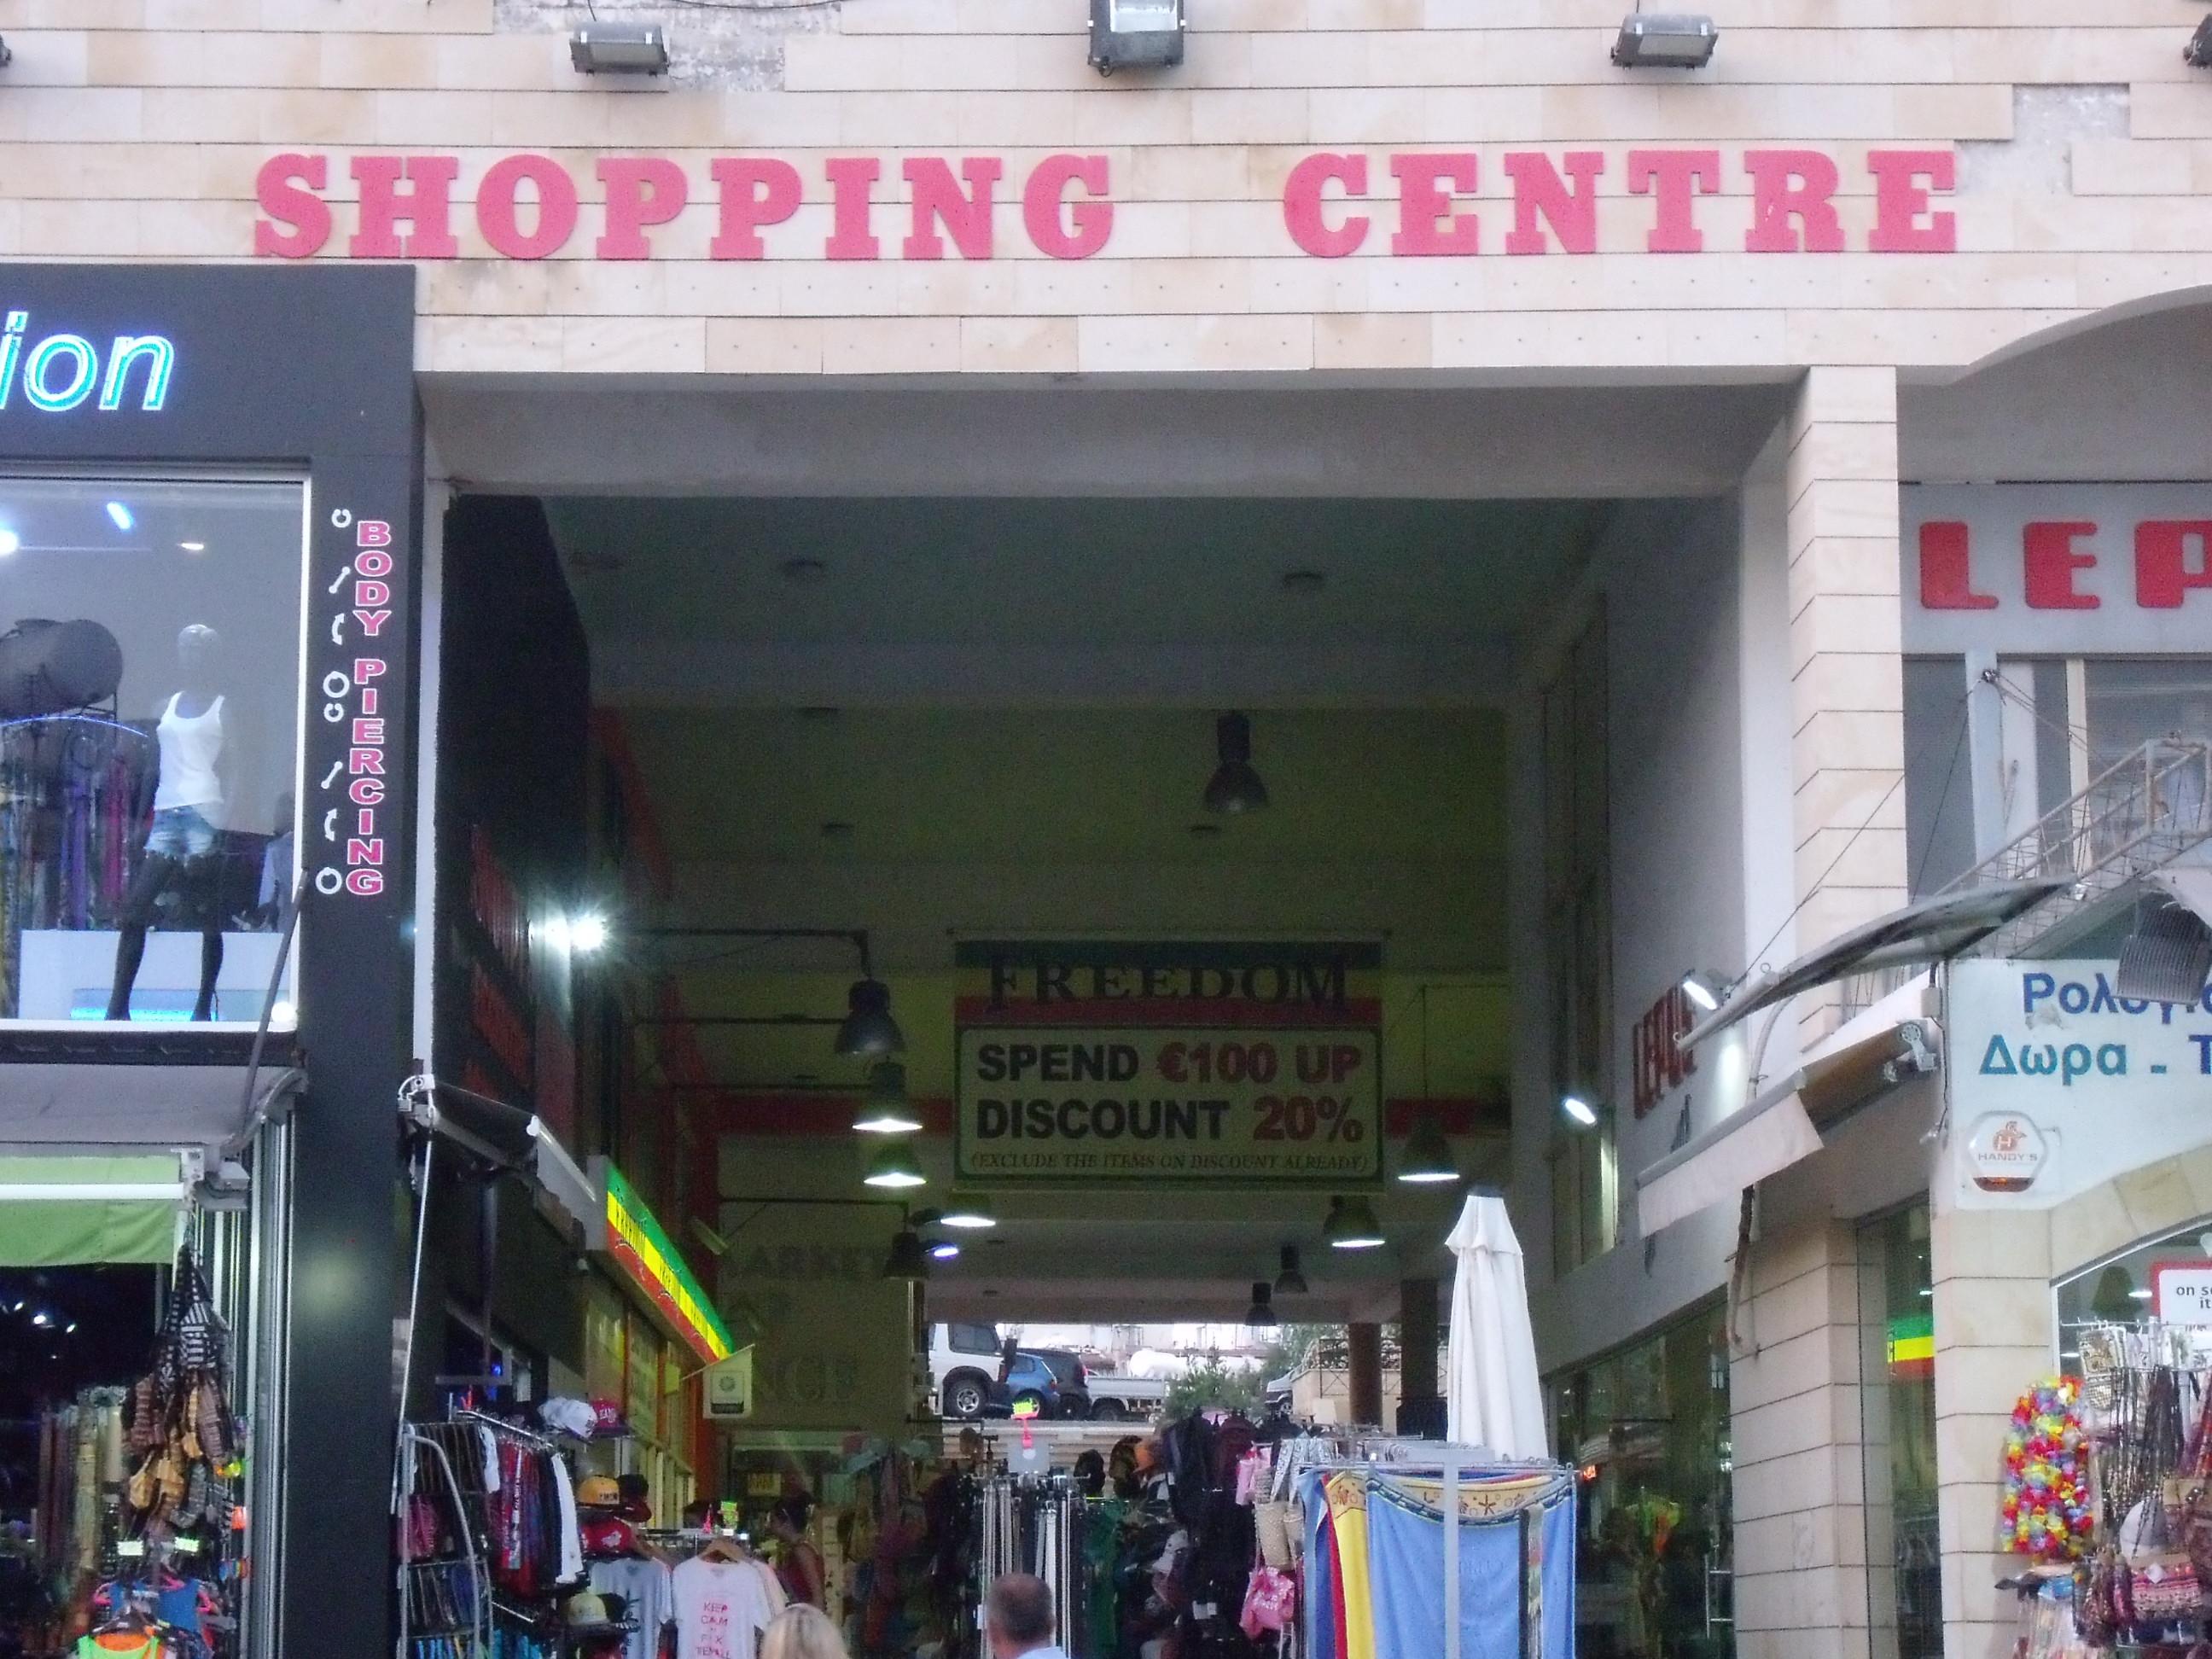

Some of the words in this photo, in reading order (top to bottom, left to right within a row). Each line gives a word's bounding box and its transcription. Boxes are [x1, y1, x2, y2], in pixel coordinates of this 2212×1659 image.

[255, 154, 1115, 259] SHOPPING
[1284, 150, 1956, 258] CENTRE
[0, 311, 174, 411] ion
[352, 521, 392, 636] BODY
[1919, 521, 2212, 610] LEP
[346, 659, 386, 895] PIERCING
[986, 952, 1353, 1014] FREEDOM
[976, 1043, 1139, 1082] SPEND
[1155, 1041, 1278, 1084] €100
[1295, 1043, 1362, 1083] UP
[1979, 1034, 2127, 1086] Δωρα
[976, 1099, 1230, 1140] DISCOUNT
[1253, 1096, 1365, 1143] 20%
[1063, 1153, 1097, 1170] THE
[1103, 1153, 1155, 1170] ITEMS
[1161, 1153, 1185, 1170] ON
[1190, 1153, 1279, 1170] DISCOUNT
[1978, 1152, 2038, 1161] HANDY'S
[2176, 1286, 2196, 1296] on
